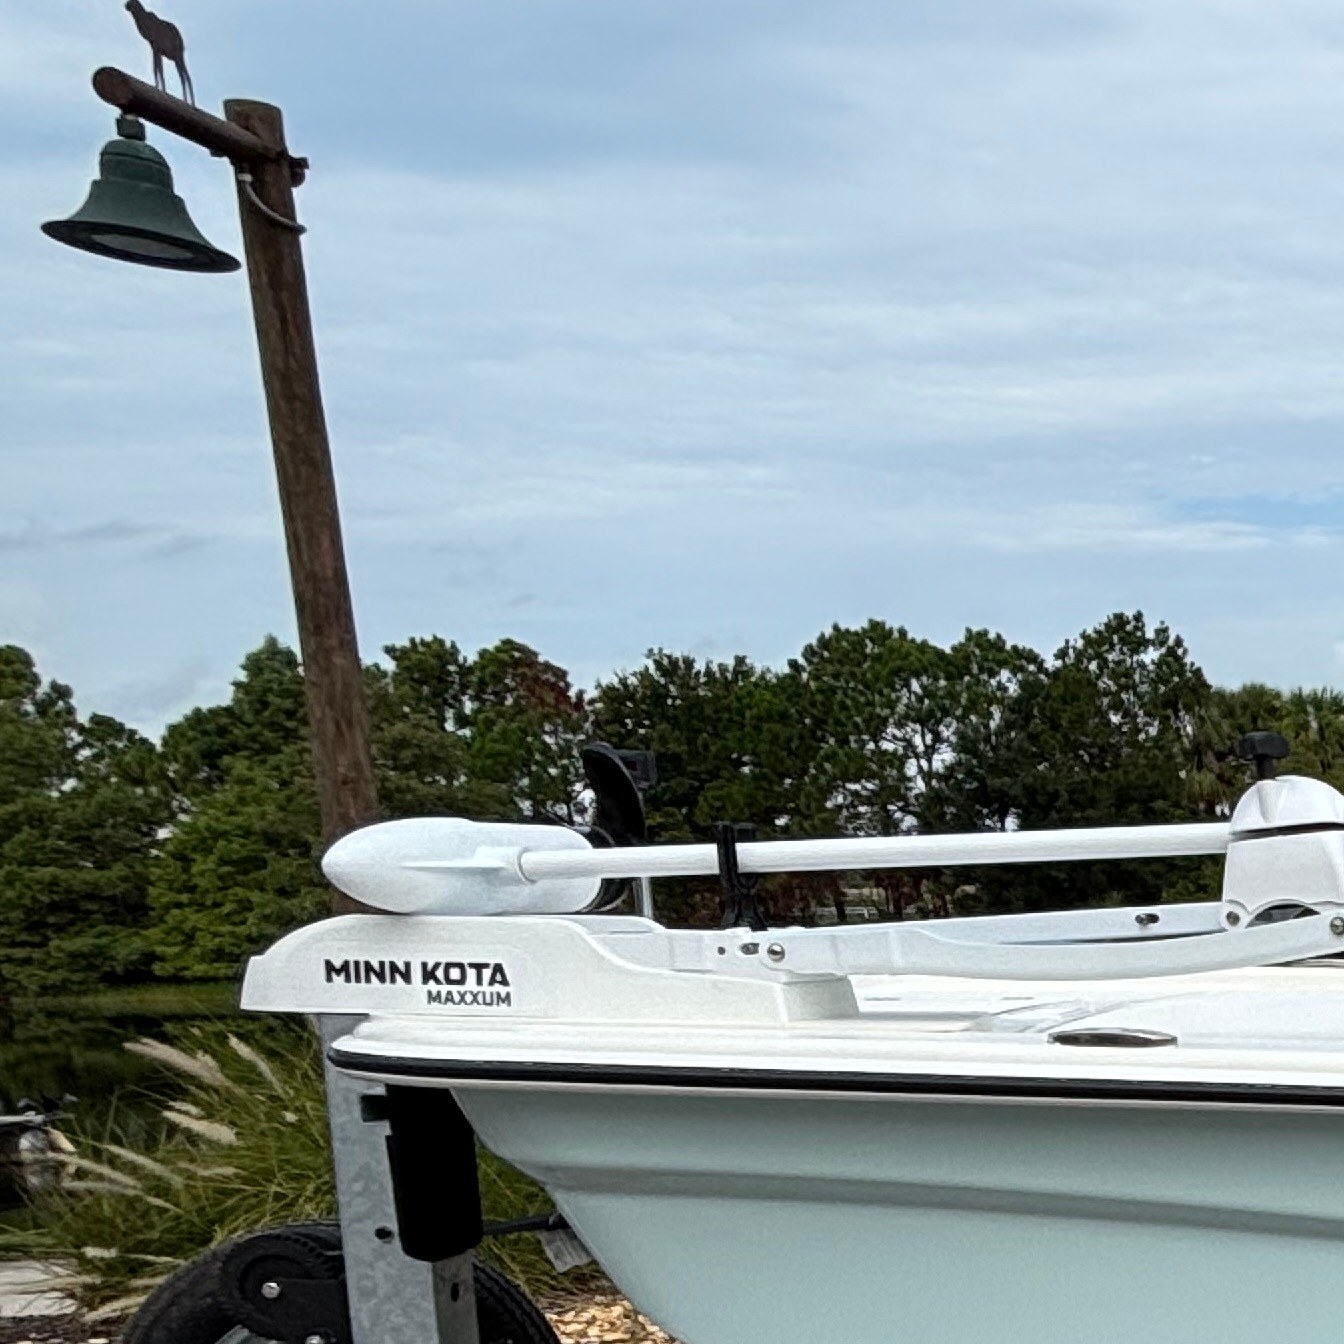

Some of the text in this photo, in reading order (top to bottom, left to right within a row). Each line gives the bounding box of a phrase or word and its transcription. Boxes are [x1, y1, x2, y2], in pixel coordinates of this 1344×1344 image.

[324, 959, 510, 987] MINN KOTA
[427, 989, 512, 1007] MAXXUM
